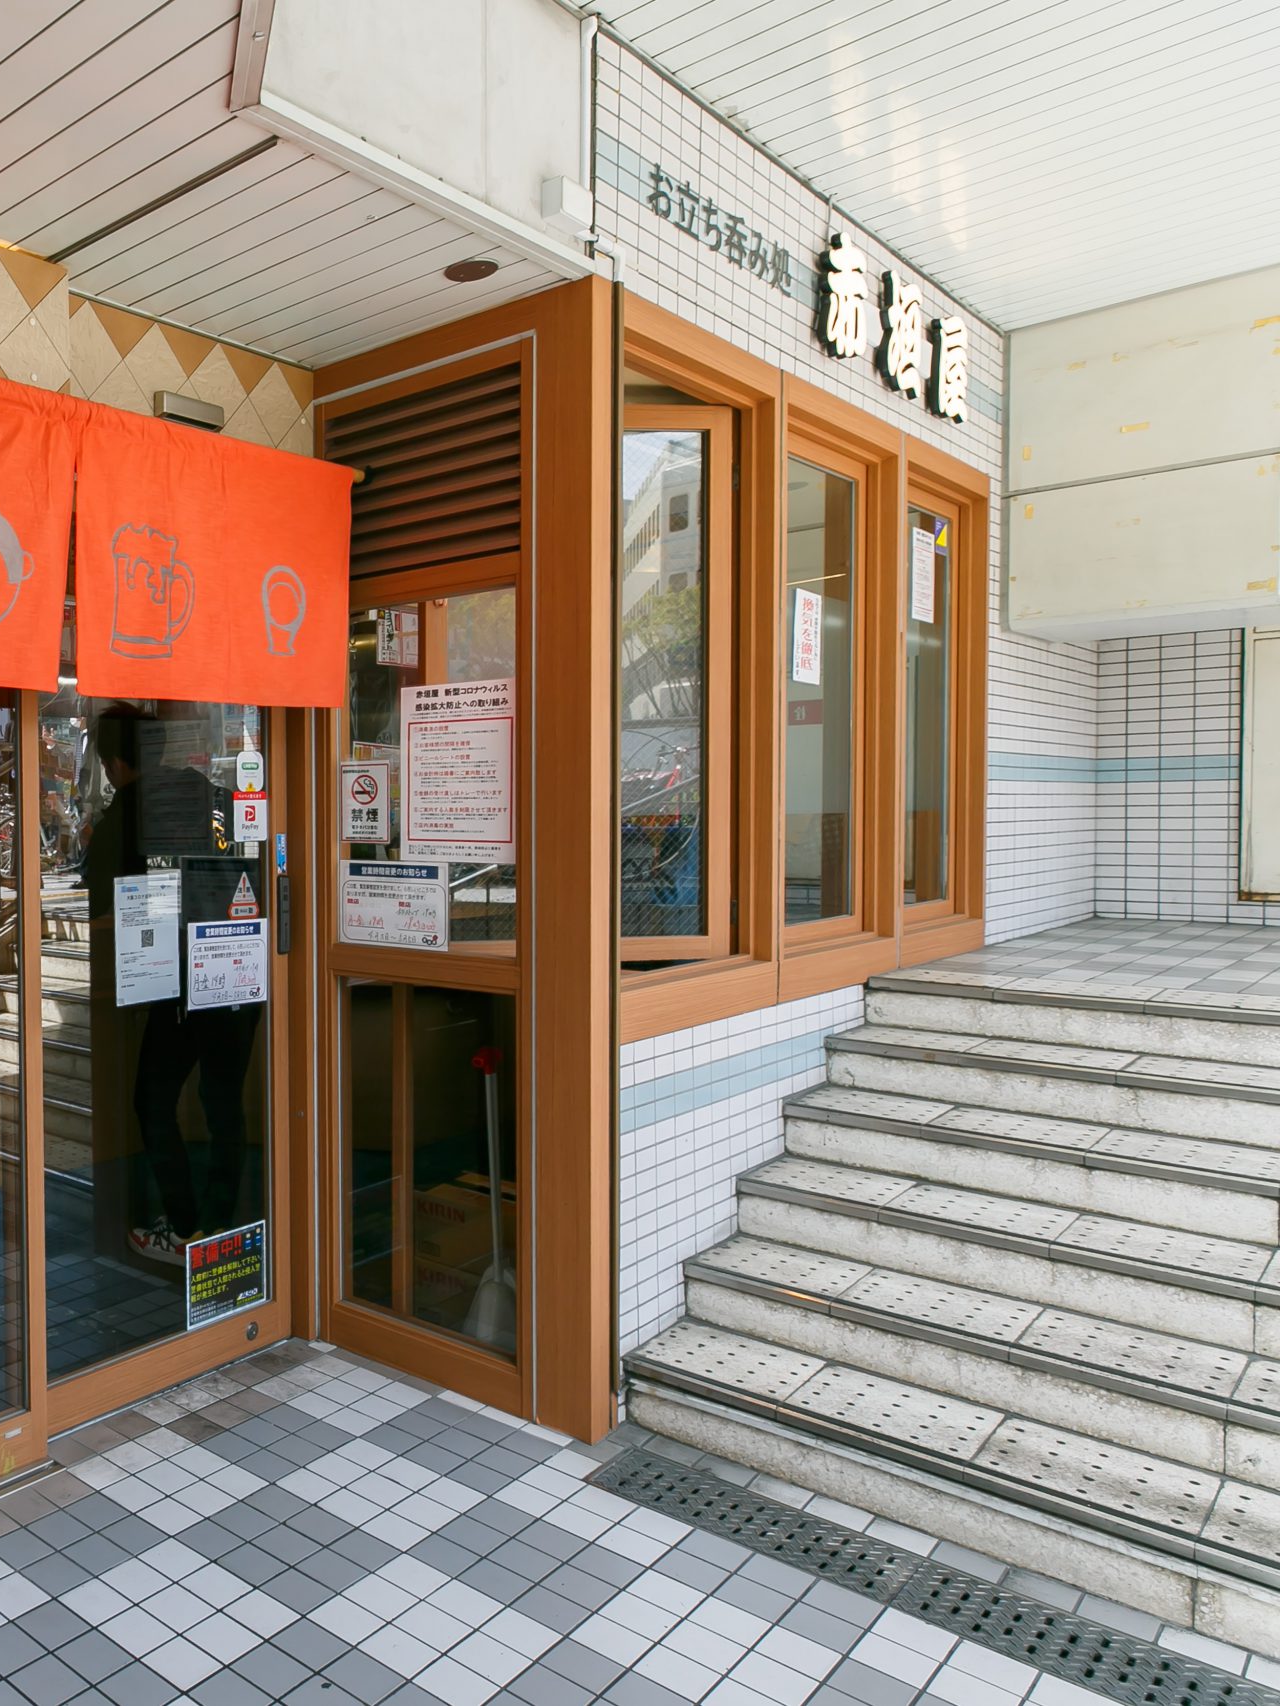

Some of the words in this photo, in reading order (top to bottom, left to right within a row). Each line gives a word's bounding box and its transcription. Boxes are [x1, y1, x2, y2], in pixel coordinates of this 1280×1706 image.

[646, 163, 791, 298] お立ち呑み処
[416, 689, 439, 698] 赤垣屋
[445, 684, 508, 696] 新型コロナウィルス
[415, 697, 509, 711] 感染拡大防止への取り組み
[351, 808, 379, 822] 禁煙
[361, 866, 427, 877] 営業時間変更のお知らせ
[417, 1200, 466, 1223] KIRIN
[191, 1234, 242, 1269] 警備中!!
[418, 1267, 466, 1292] KIRIN
